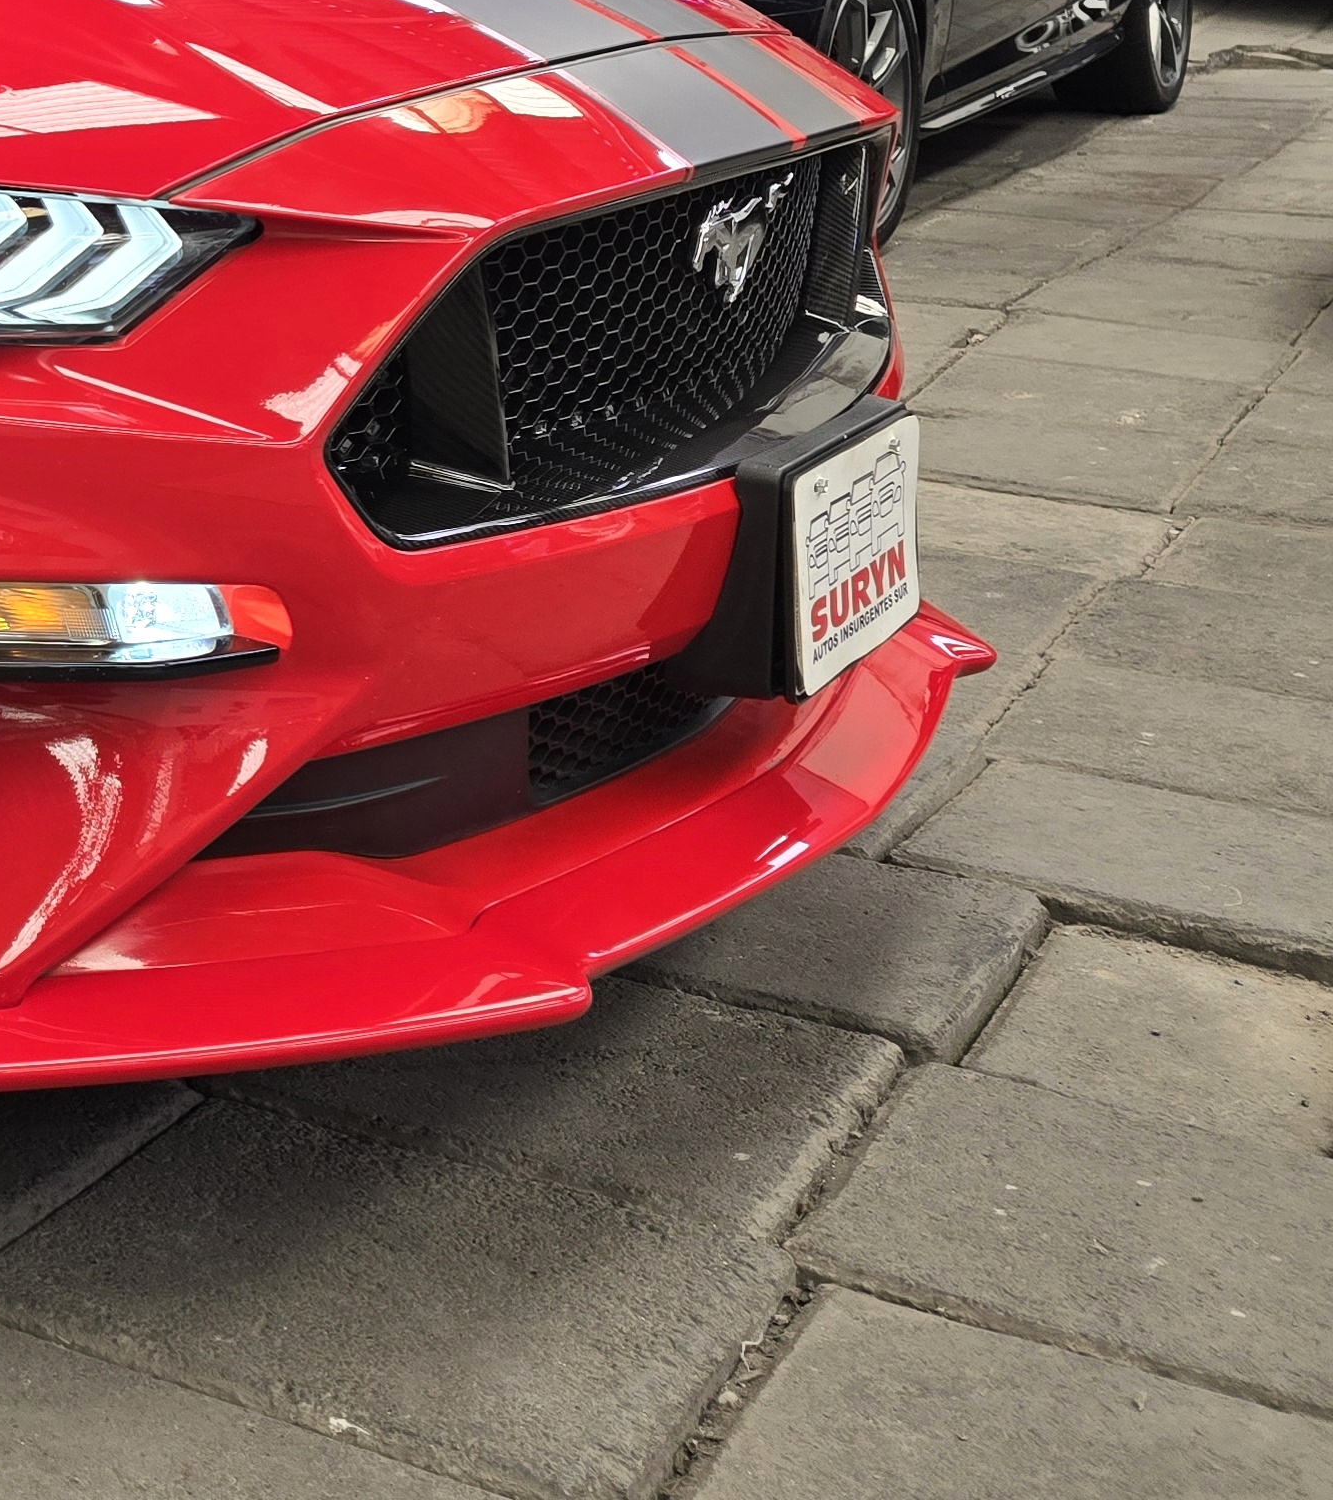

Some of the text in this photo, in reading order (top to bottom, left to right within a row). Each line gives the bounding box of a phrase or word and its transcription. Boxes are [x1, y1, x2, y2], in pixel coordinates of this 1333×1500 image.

[810, 541, 906, 642] SURYN
[812, 583, 908, 664] AUTOS INSURGENTES SUR
